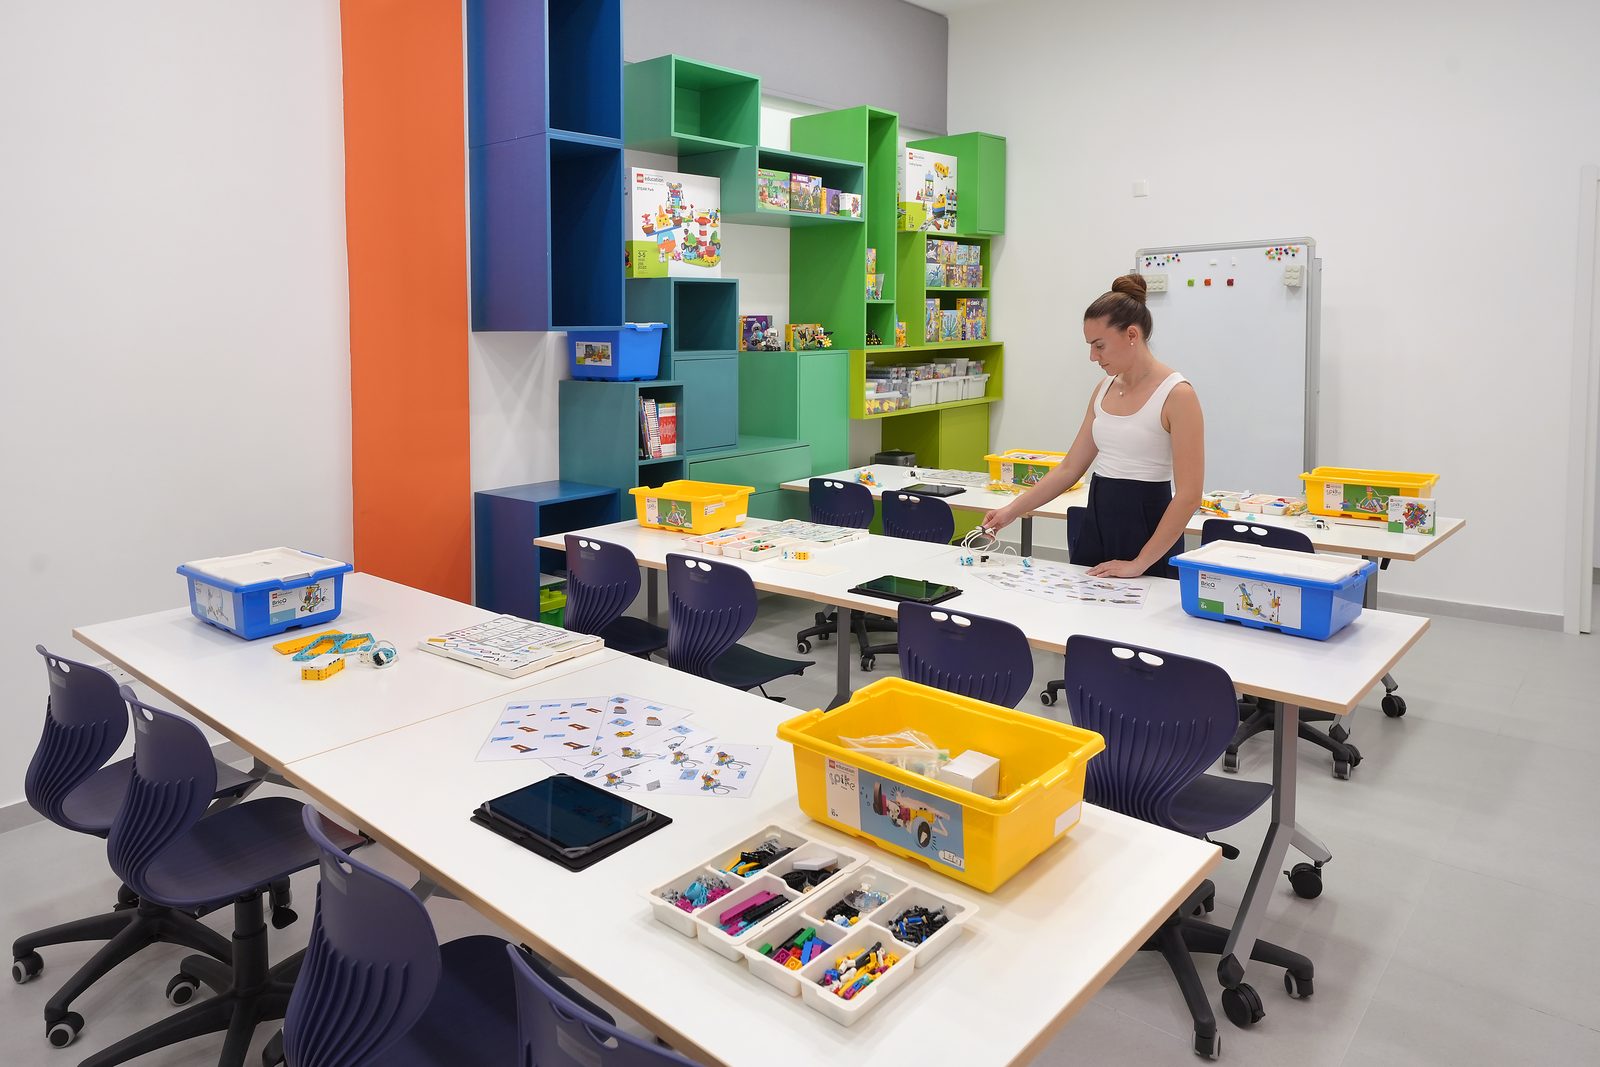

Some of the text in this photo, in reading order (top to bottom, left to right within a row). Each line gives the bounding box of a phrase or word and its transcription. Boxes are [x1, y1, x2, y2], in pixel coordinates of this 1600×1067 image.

[272, 597, 287, 605] BricQ
[836, 764, 855, 773] education
[829, 772, 856, 790] spike
